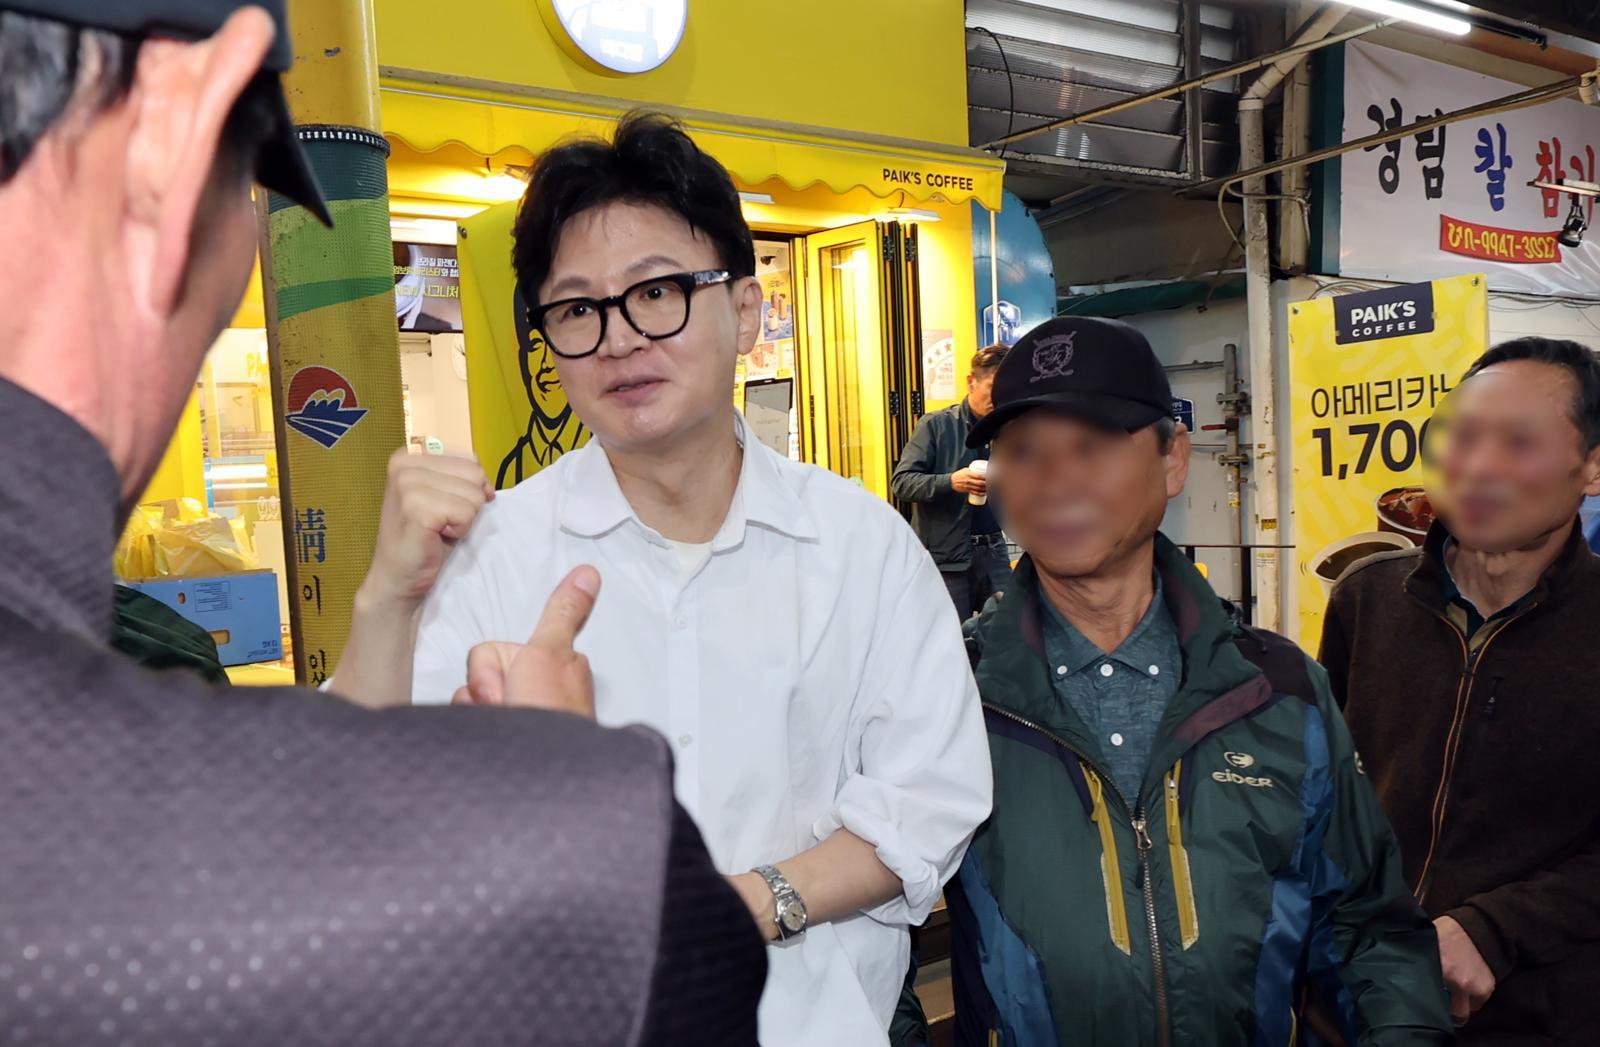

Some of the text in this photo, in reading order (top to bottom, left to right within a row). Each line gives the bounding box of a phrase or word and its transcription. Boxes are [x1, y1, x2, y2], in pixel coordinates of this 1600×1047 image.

[883, 168, 973, 191] PAIK'S COFFEE
[1474, 123, 1513, 211] 칼
[1351, 300, 1416, 325] PAIK'S
[1352, 321, 1416, 337] COFFEE
[1312, 417, 1431, 480] 1,70
